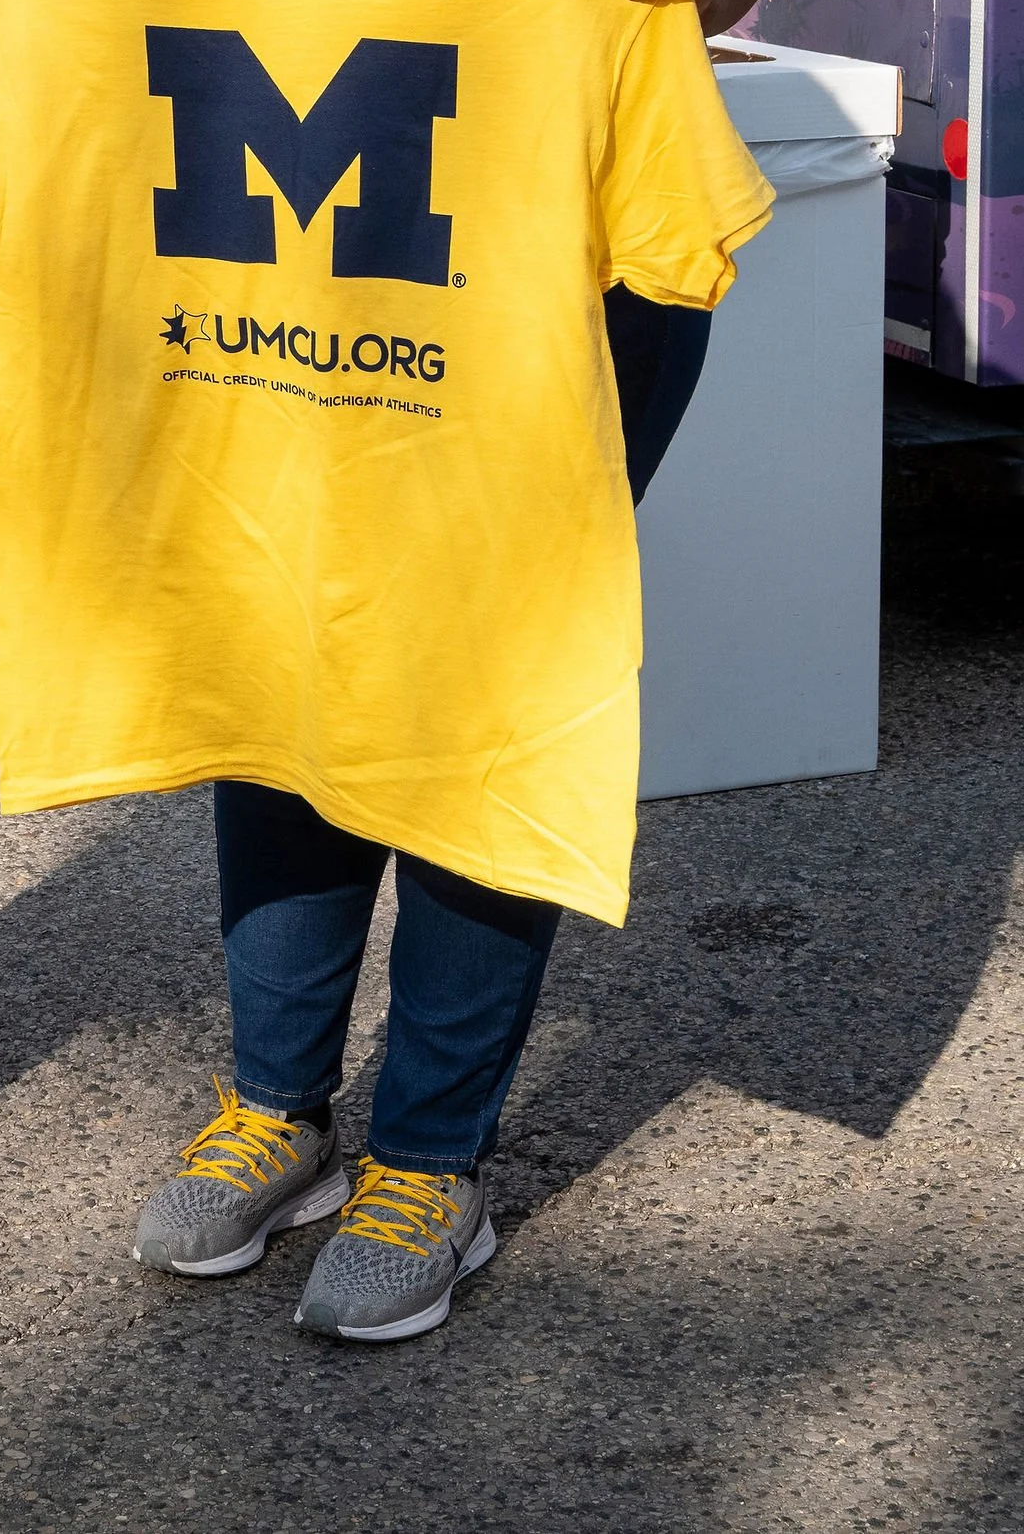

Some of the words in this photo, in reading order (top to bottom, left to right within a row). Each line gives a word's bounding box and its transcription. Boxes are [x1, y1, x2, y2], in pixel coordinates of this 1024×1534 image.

[215, 314, 446, 383] UMCU.ORG
[162, 369, 219, 384] OFFICIAL
[223, 375, 267, 389] CREDIT
[271, 381, 306, 398] UNION
[307, 391, 317, 403] OF
[319, 395, 383, 408] MICHIGAN
[386, 398, 442, 419] ATHLETICS
